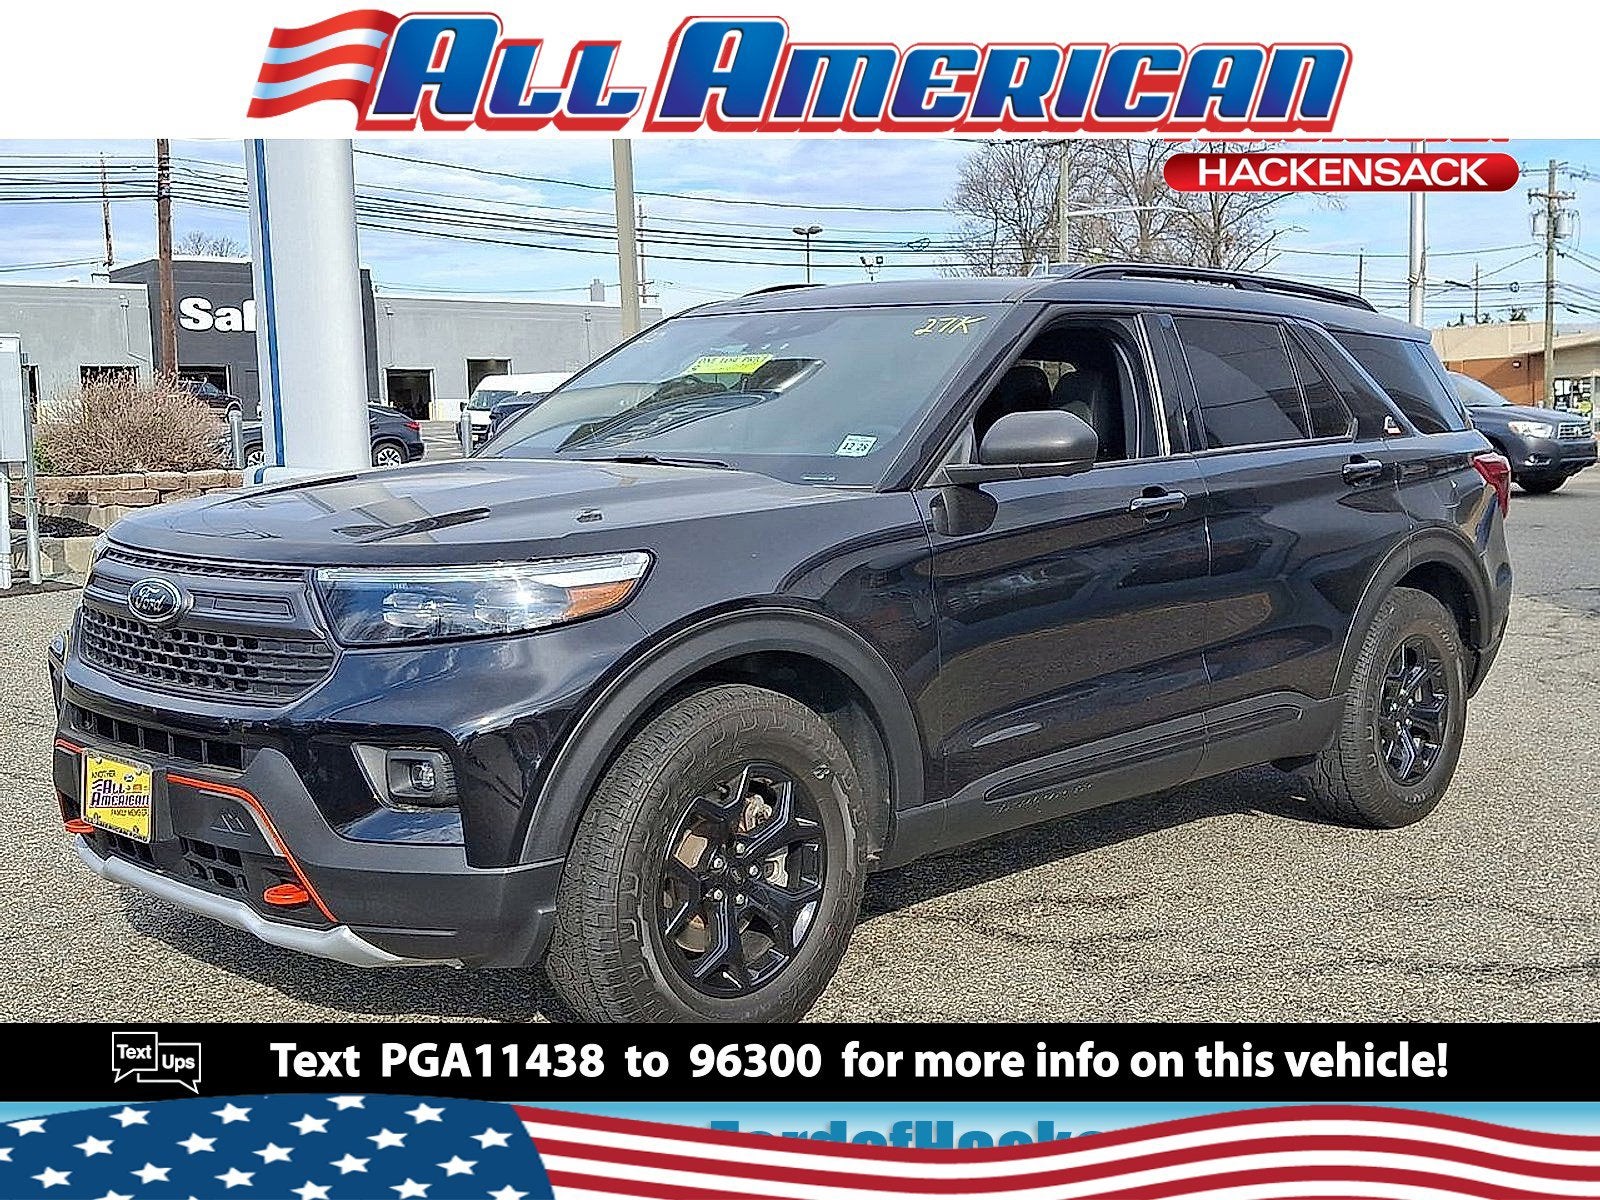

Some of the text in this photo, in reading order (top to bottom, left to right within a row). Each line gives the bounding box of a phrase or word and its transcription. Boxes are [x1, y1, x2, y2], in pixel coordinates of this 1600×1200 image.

[914, 315, 988, 335] 27K
[136, 586, 167, 612] Ford
[102, 779, 126, 795] ALL
[91, 791, 149, 807] AMERICAN
